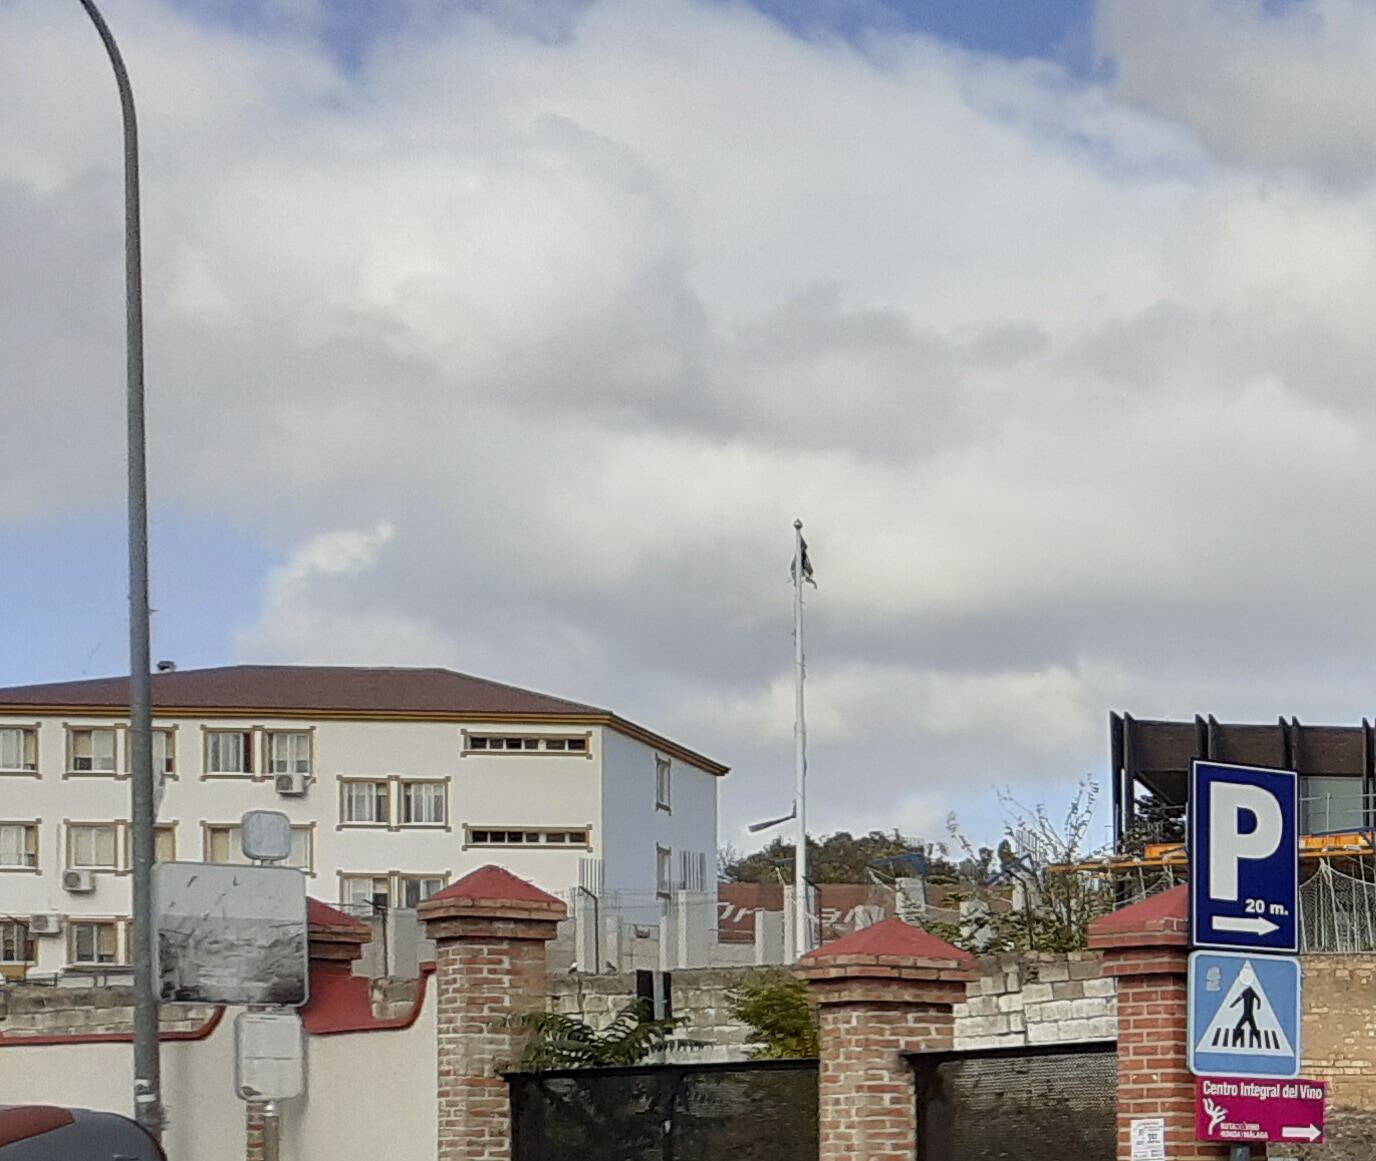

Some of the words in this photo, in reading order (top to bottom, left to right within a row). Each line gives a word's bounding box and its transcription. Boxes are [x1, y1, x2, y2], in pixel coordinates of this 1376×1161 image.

[1210, 781, 1283, 901] P
[1245, 899, 1265, 913] 20
[1270, 903, 1288, 915] m.
[1203, 1080, 1238, 1096] Centro
[1240, 1082, 1280, 1100] Integral
[1282, 1085, 1298, 1098] del
[1299, 1085, 1323, 1099] Vino
